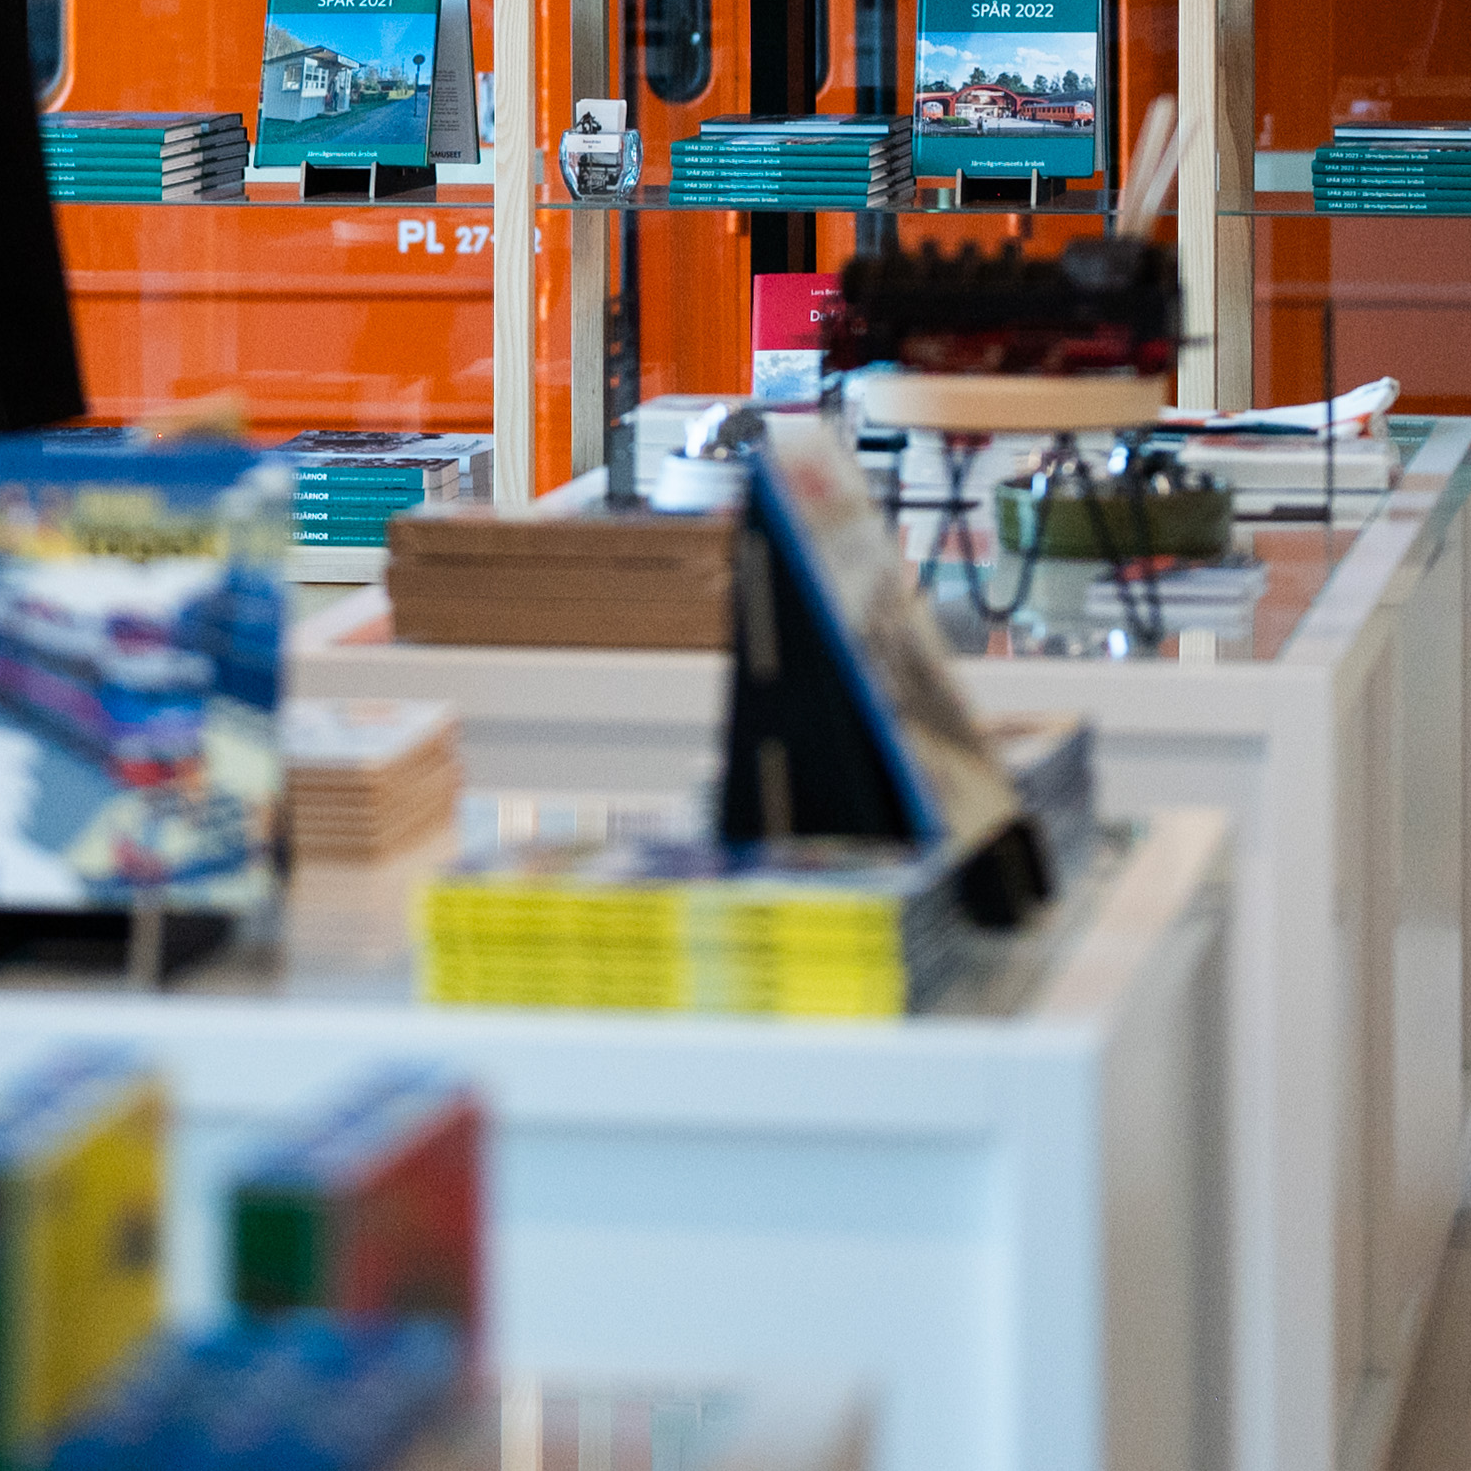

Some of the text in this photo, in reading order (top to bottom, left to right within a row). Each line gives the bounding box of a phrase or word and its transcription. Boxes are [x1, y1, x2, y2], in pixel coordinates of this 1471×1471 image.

[971, 0, 1054, 19] SPÅR 2022
[307, 150, 356, 158] Järnvägsmuseets
[398, 220, 444, 253] PL
[292, 472, 327, 481] STJÄRNOR
[292, 492, 329, 500] STJÄRNOR
[292, 512, 328, 521] STJÄRNOR
[292, 532, 328, 540] STJÄRNOR
